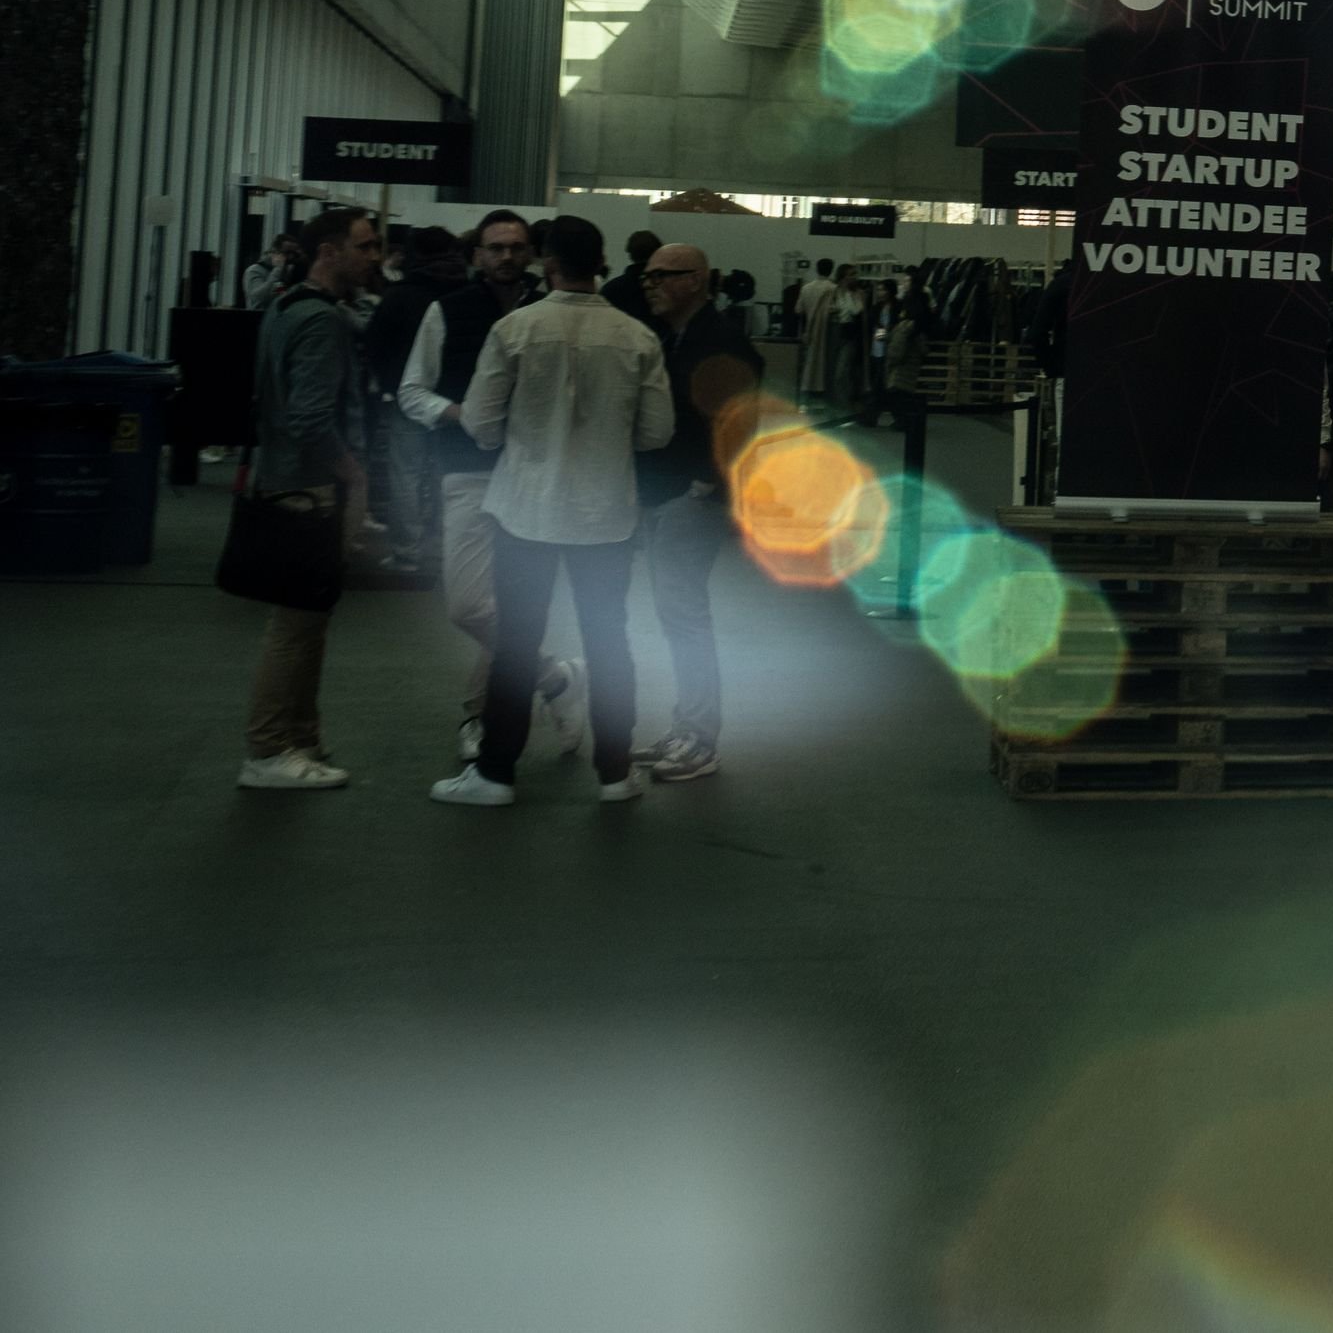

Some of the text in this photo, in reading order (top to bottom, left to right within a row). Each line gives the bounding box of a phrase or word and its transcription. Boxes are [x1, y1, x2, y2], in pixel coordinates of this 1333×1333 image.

[1119, 105, 1304, 142] STUDENT
[336, 141, 438, 160] STUDENT
[1117, 151, 1298, 188] STARTUP
[1102, 198, 1307, 235] ATTENDEE
[1083, 243, 1320, 281] VOLUNTEER
